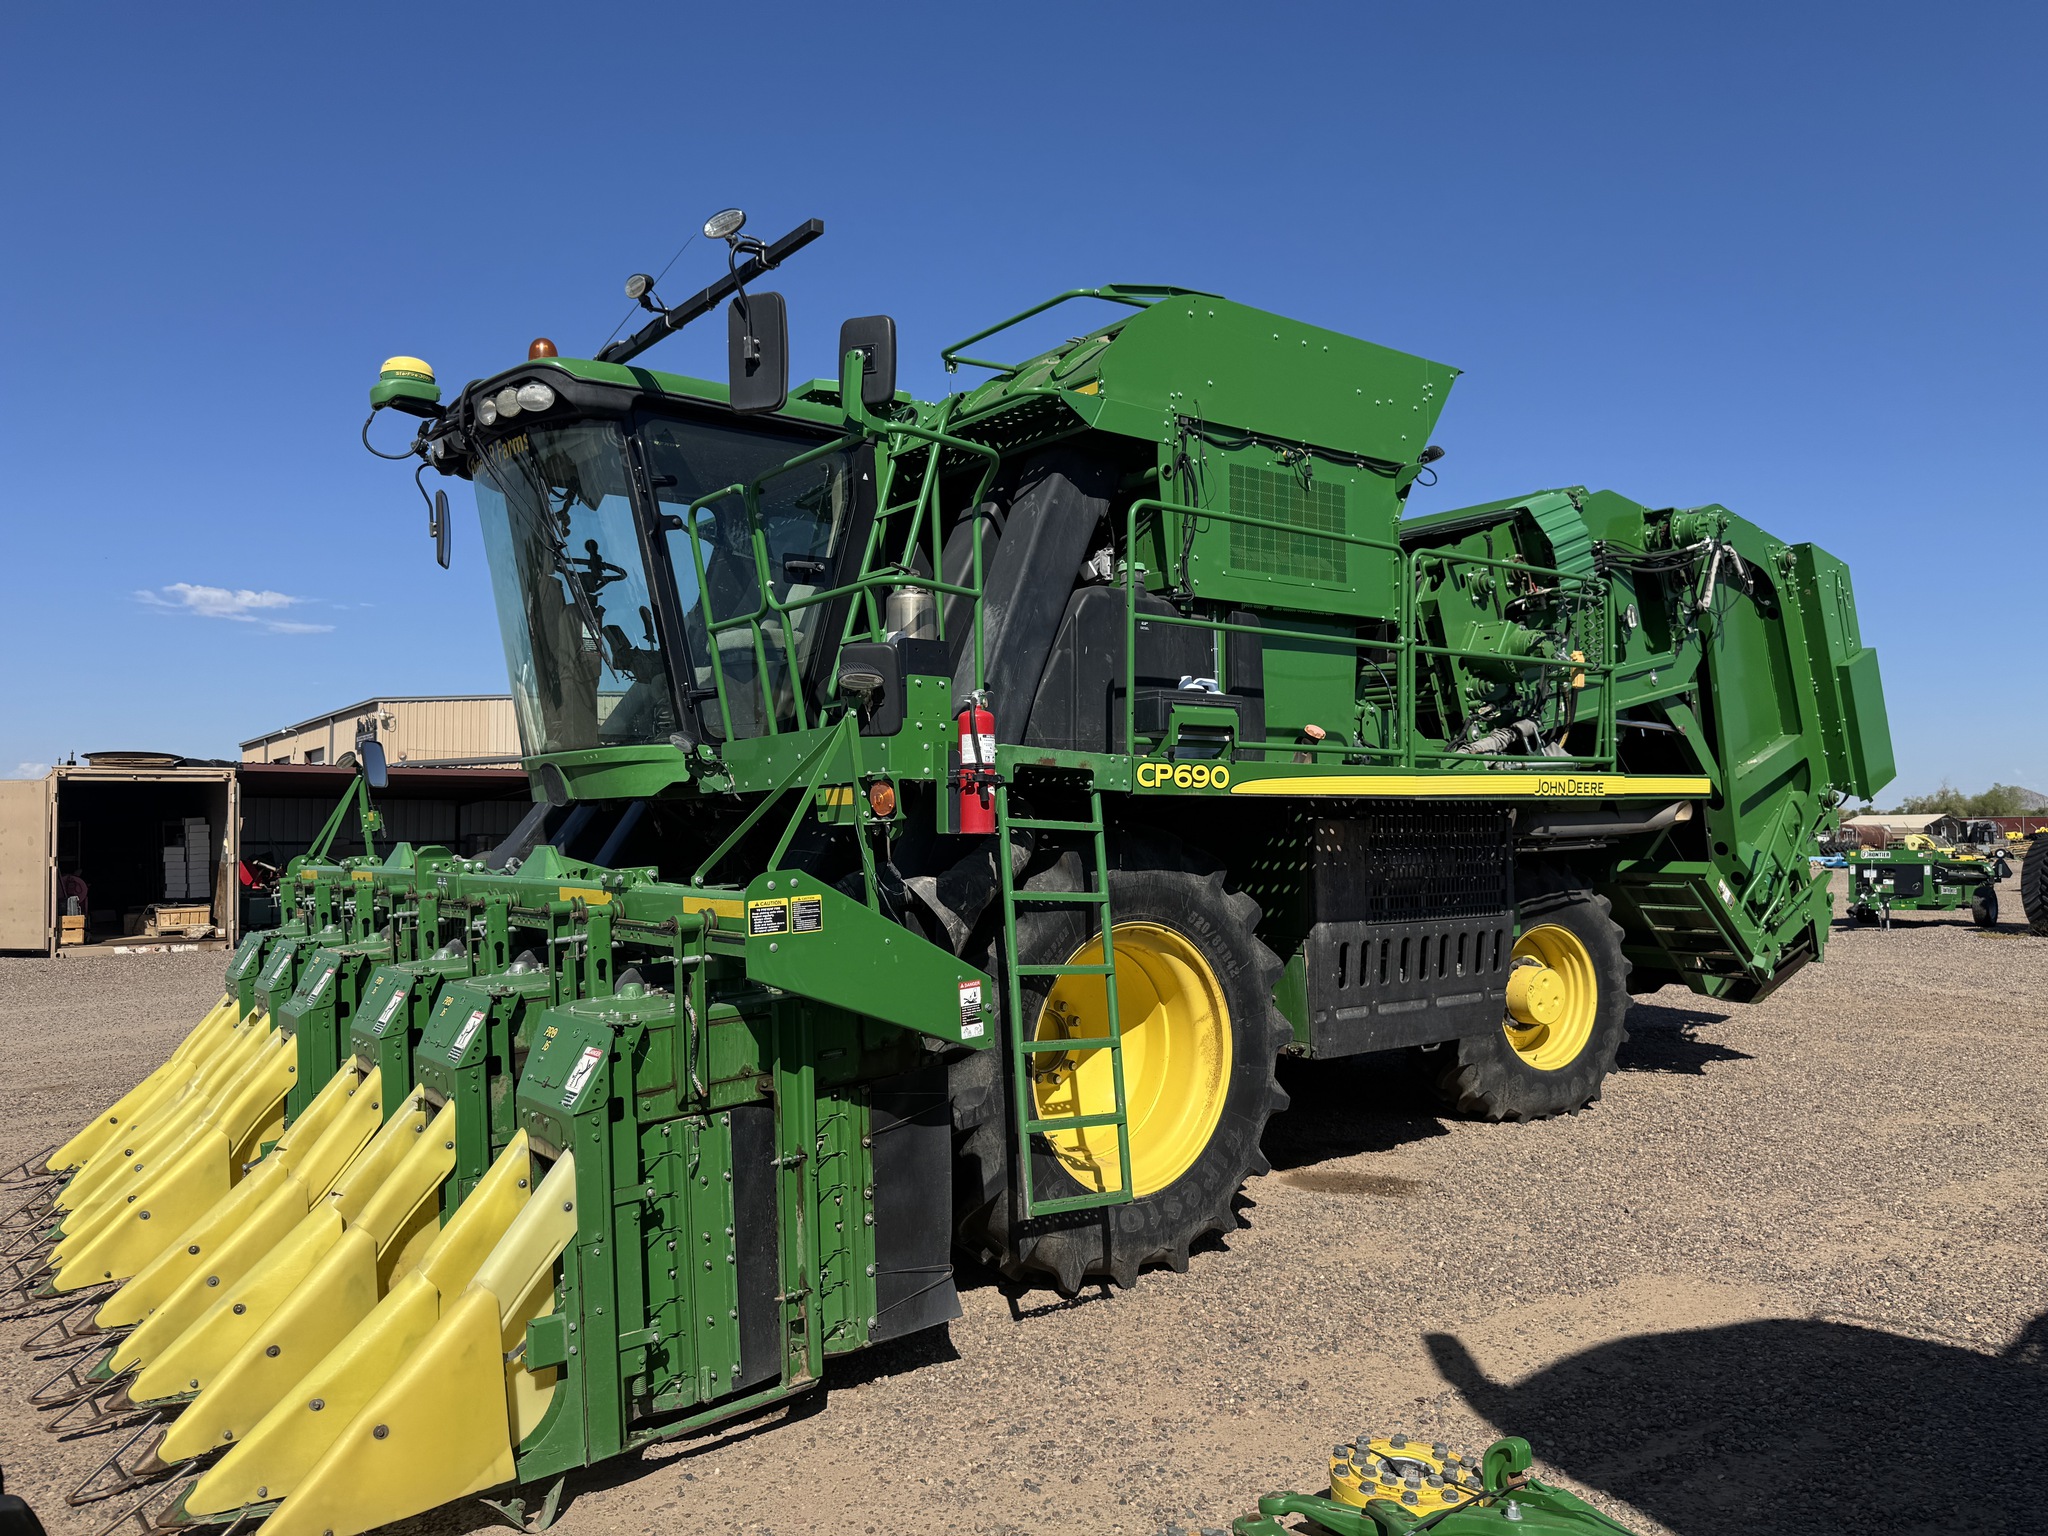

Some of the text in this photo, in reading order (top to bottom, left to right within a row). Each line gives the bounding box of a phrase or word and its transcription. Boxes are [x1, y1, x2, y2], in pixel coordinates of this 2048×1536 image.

[496, 433, 530, 463] Farms
[1136, 762, 1230, 790] CP690
[1535, 779, 1605, 796] JOHN DEERE
[1188, 911, 1240, 978] 520/85R42
[964, 980, 981, 988] DANGER
[1046, 1128, 1243, 1233] Firestoe
